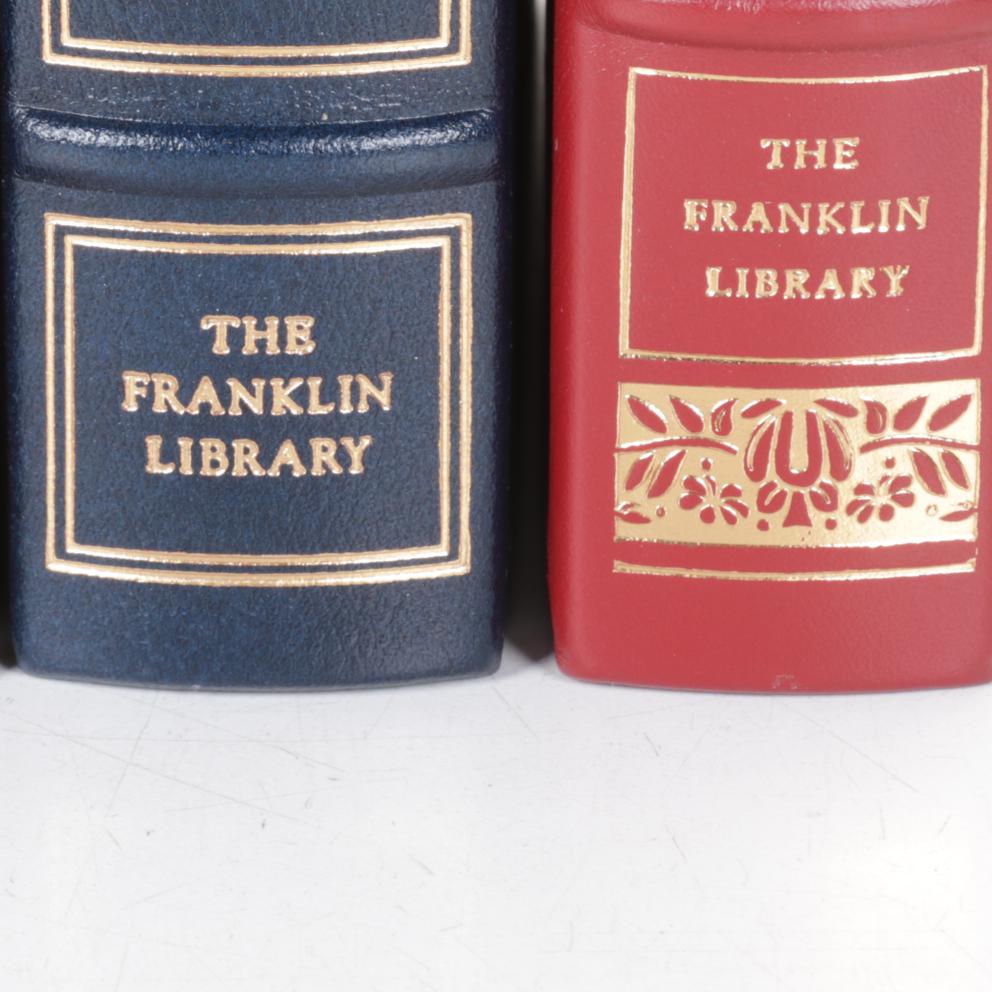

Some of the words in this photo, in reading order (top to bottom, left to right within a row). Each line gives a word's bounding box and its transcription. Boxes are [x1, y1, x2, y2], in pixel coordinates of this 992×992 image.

[760, 136, 861, 171] THE
[683, 196, 930, 236] FRANKLIN
[705, 265, 910, 301] LIBRARY
[200, 314, 317, 356] THE
[121, 371, 394, 417] FRANKLIN
[145, 435, 373, 478] LIBRARY
